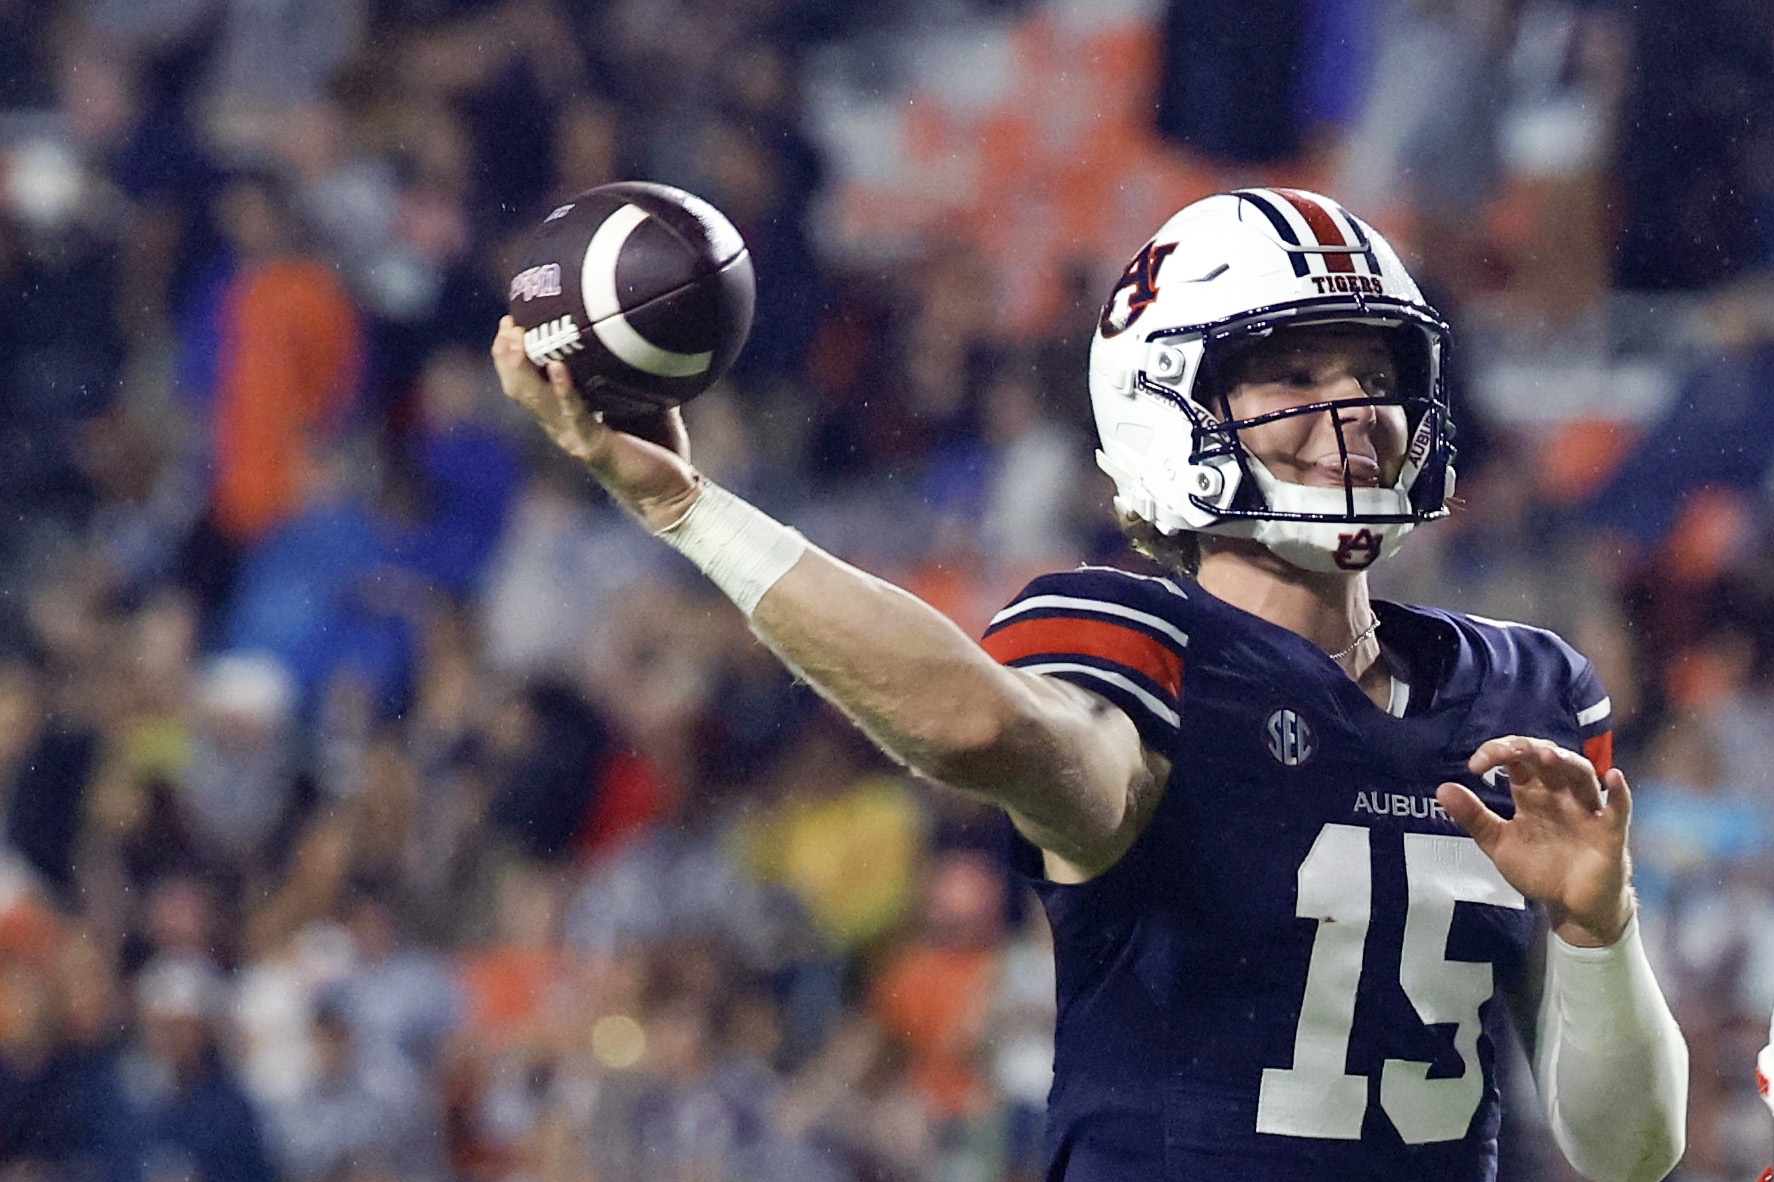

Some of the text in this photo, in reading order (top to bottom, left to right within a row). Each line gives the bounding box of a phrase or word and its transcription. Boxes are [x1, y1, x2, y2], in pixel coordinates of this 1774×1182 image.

[1311, 274, 1383, 296] TIGERS
[1267, 709, 1312, 767] SEC
[1353, 790, 1456, 822] AUBUR
[1255, 822, 1526, 1145] 15
